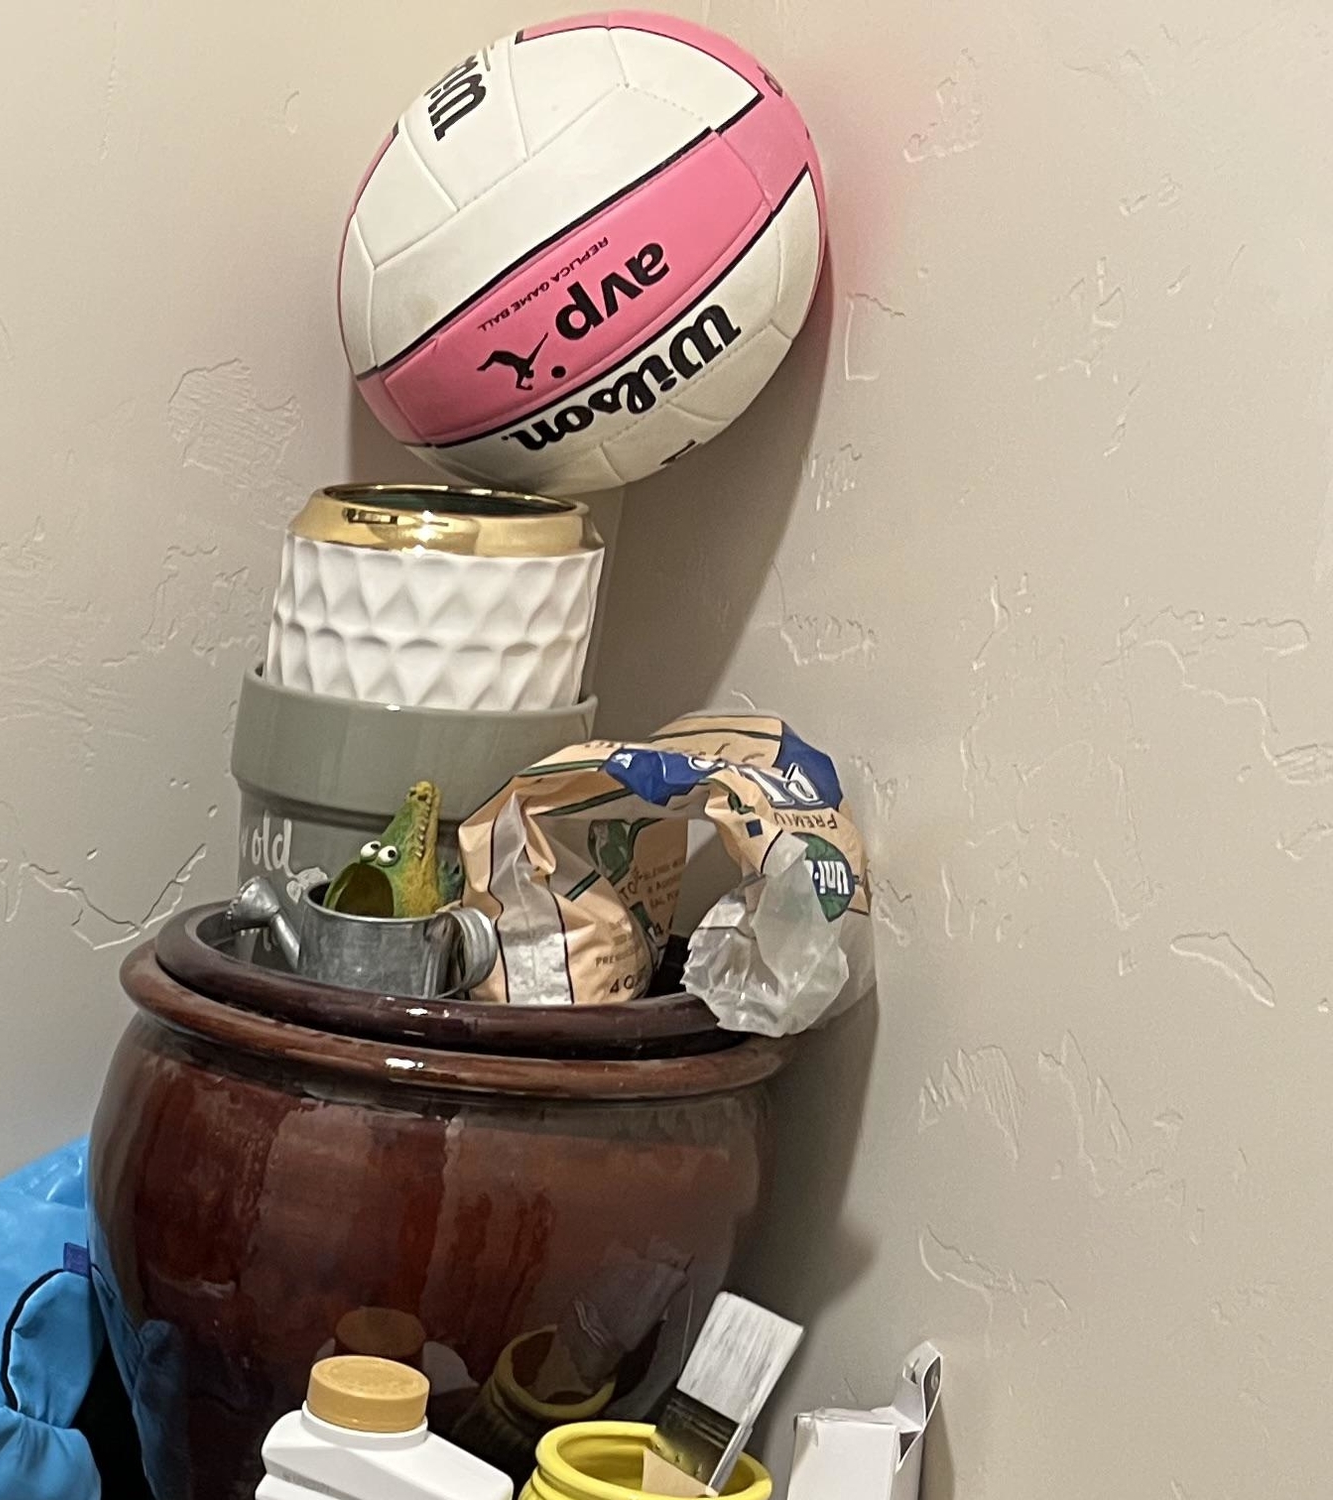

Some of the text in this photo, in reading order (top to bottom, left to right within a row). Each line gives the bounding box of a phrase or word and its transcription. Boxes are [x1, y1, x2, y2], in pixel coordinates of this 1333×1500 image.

[478, 237, 609, 331] REPLICA GAME BALL
[555, 241, 670, 340] avp
[509, 304, 741, 451] Wilson
[774, 811, 838, 829] PREMIU
